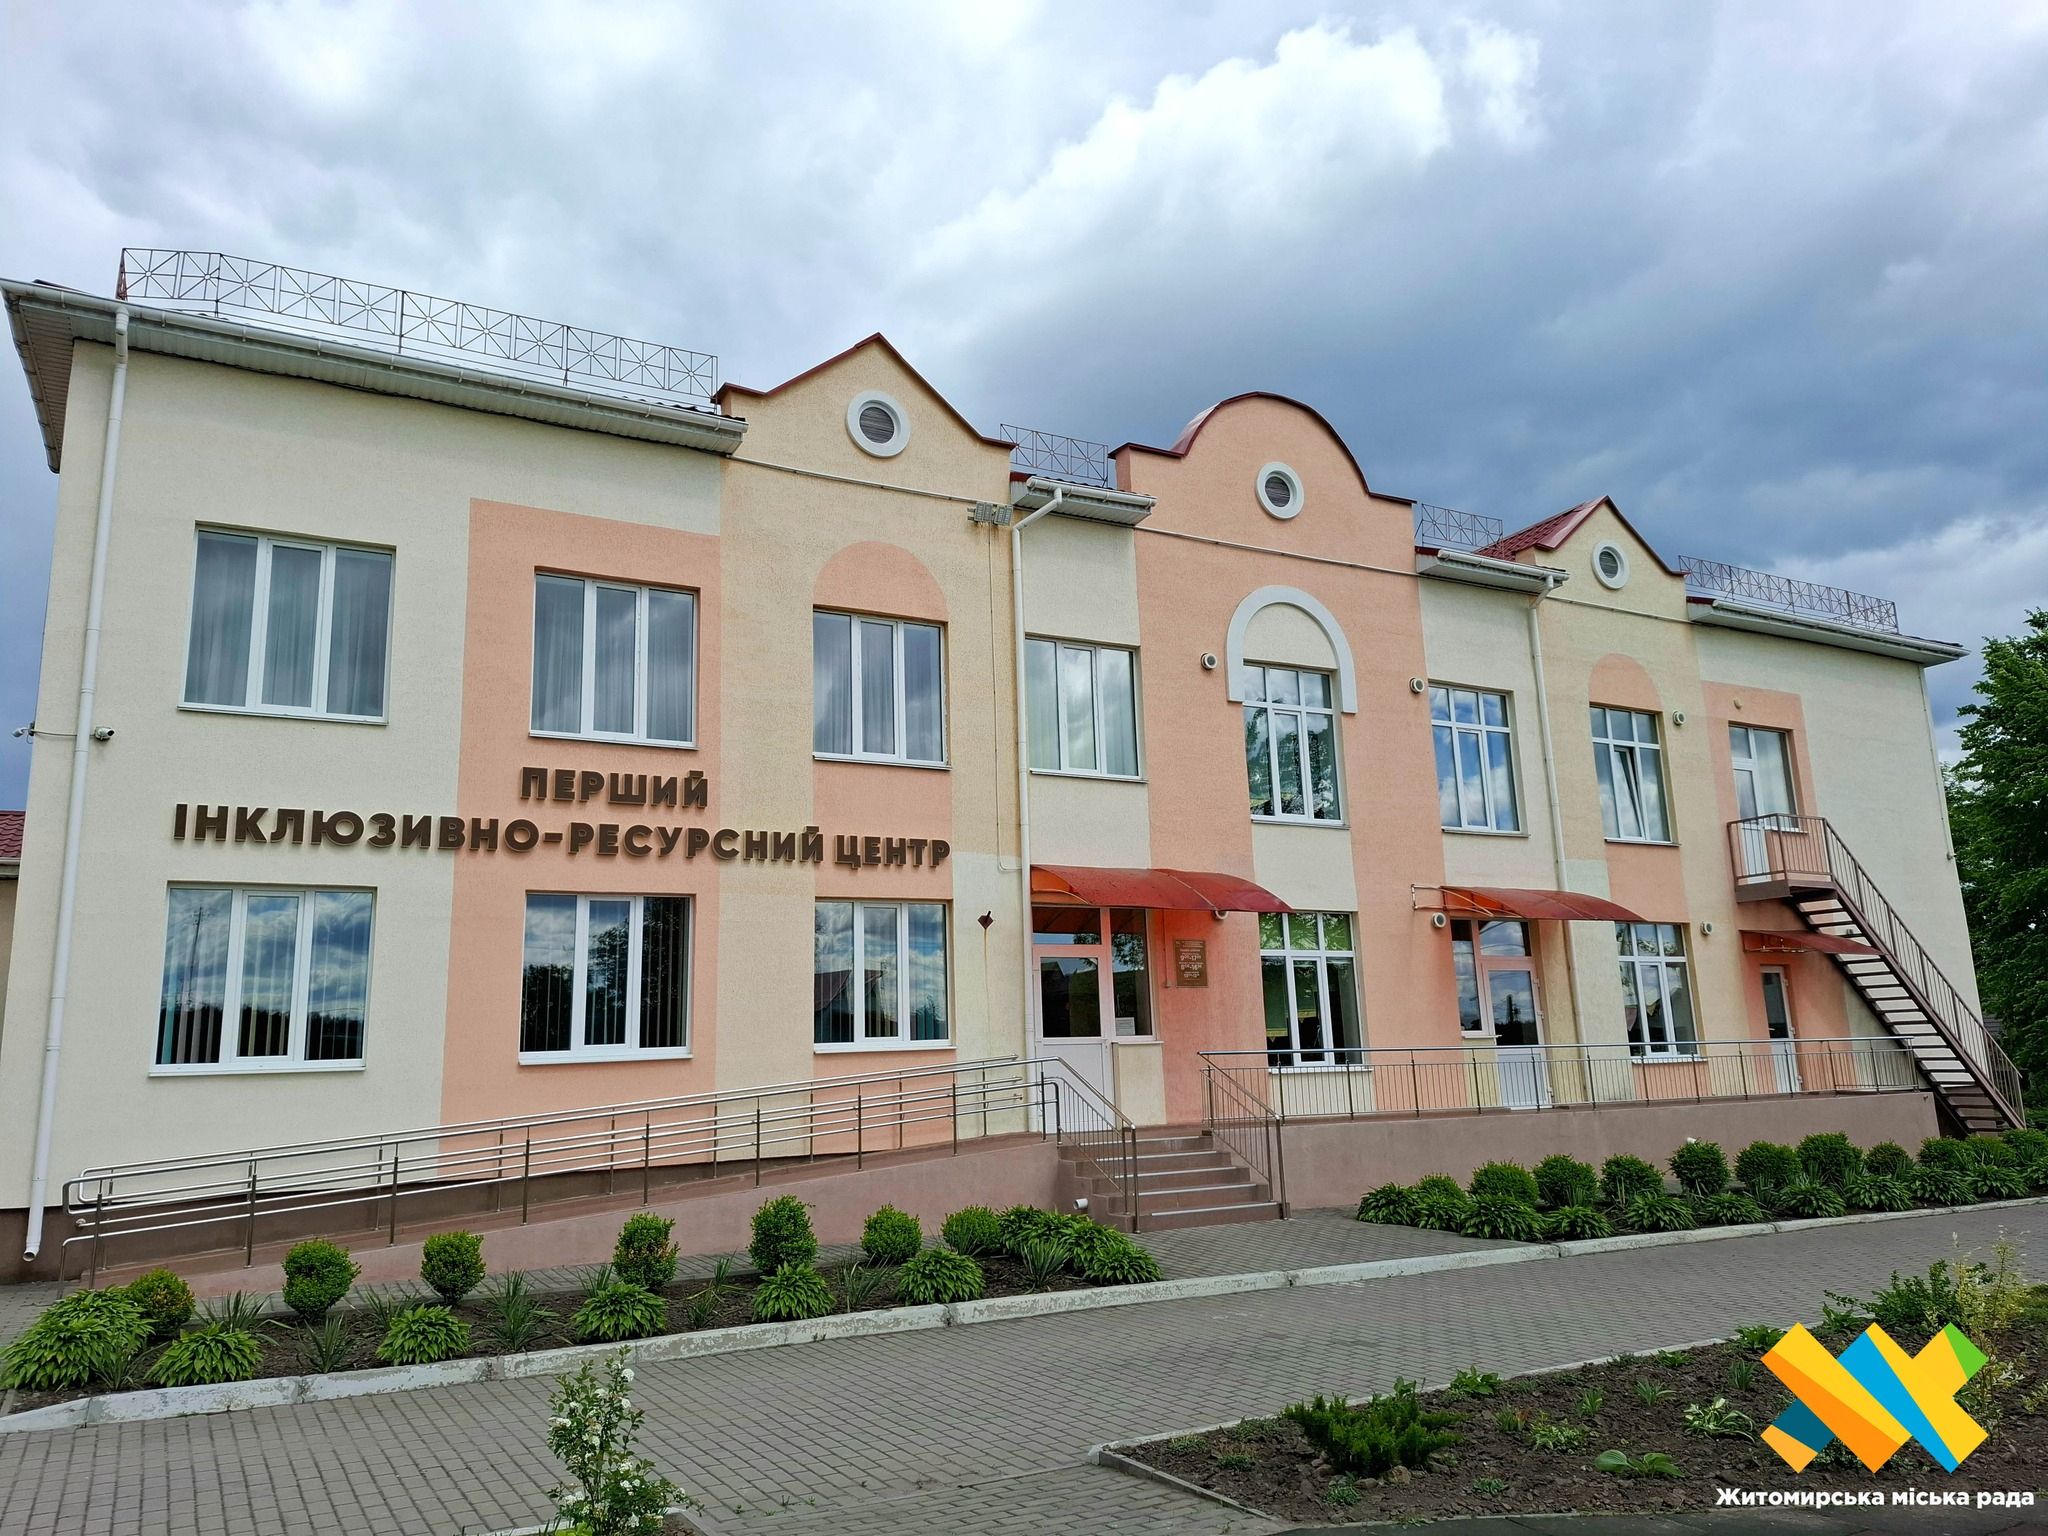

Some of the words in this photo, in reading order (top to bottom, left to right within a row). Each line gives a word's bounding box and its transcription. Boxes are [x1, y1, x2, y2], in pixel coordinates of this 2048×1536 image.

[520, 766, 709, 809] ПЕРШИЙ
[173, 803, 824, 862] ІНКЛЮЗИВНО-РЕСУРСНИЙ
[834, 834, 951, 870] ЦЕНТР
